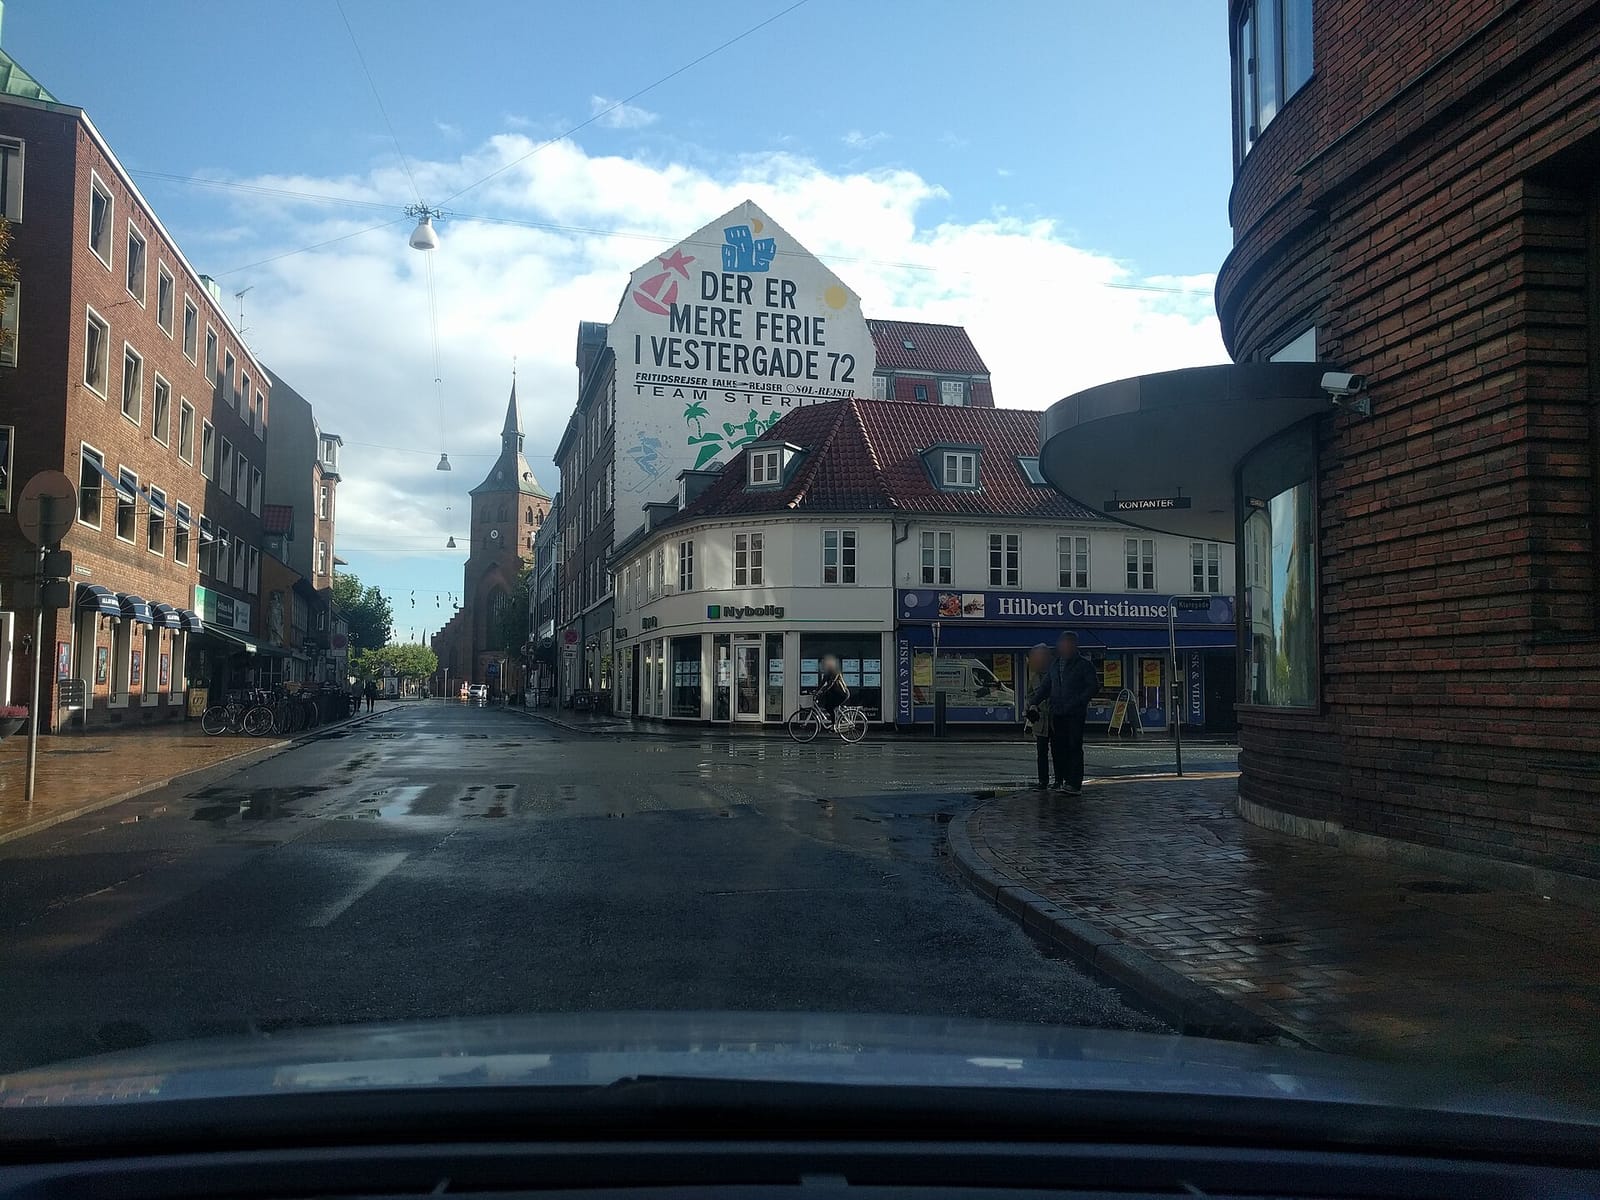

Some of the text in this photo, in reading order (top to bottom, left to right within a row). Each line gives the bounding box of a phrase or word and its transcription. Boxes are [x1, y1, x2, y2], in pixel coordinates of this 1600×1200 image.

[701, 270, 797, 309] DER ER
[669, 303, 826, 346] MERE FERIE
[634, 334, 855, 383] I VESTERGADE 72
[633, 384, 708, 400] TEAM
[635, 372, 708, 387] FRITIDSREJSER
[1118, 499, 1175, 510] KONTANTER
[723, 605, 785, 619] Nybolig
[998, 597, 1178, 618] Hilbert Christiansen
[899, 639, 909, 716] FISK & VILDT
[1191, 682, 1200, 717] VILDT
